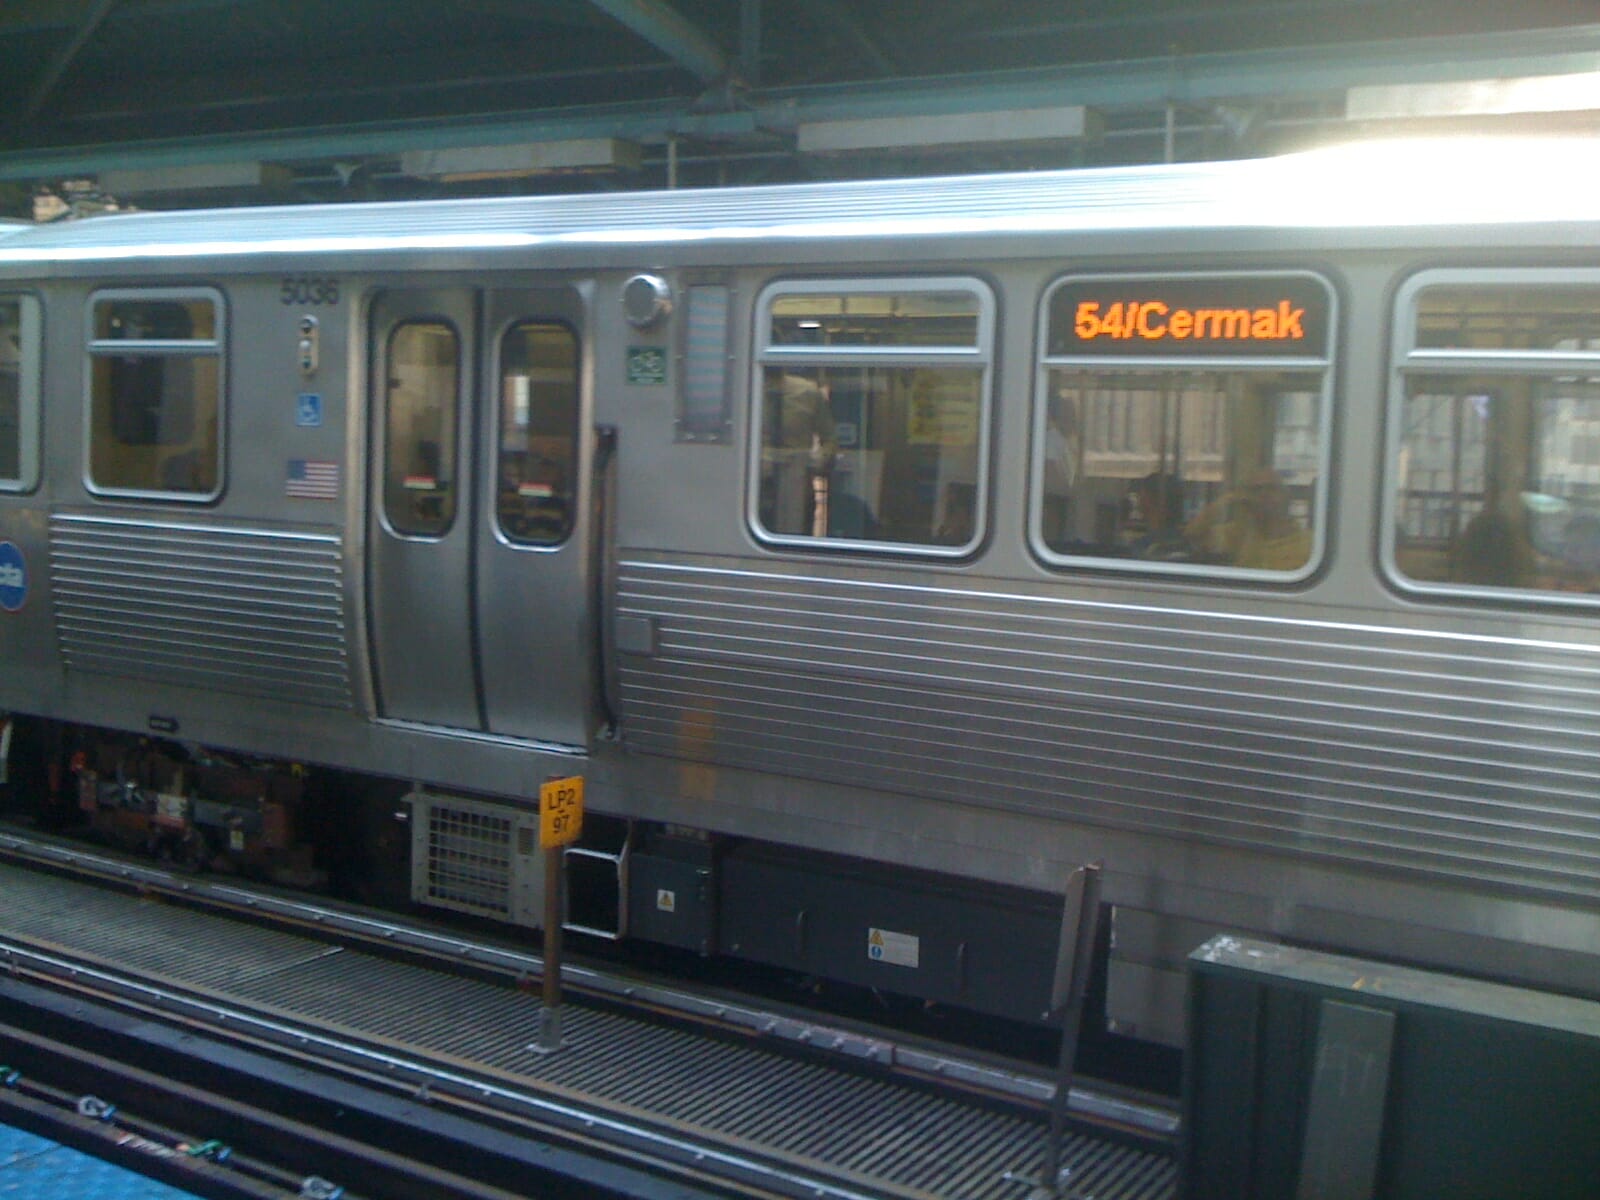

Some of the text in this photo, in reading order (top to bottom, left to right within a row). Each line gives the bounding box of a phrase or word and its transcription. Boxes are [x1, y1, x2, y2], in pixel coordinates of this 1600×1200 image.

[1075, 300, 1304, 340] 54/Cermak
[548, 788, 575, 810] LP2
[553, 815, 570, 834] 97
